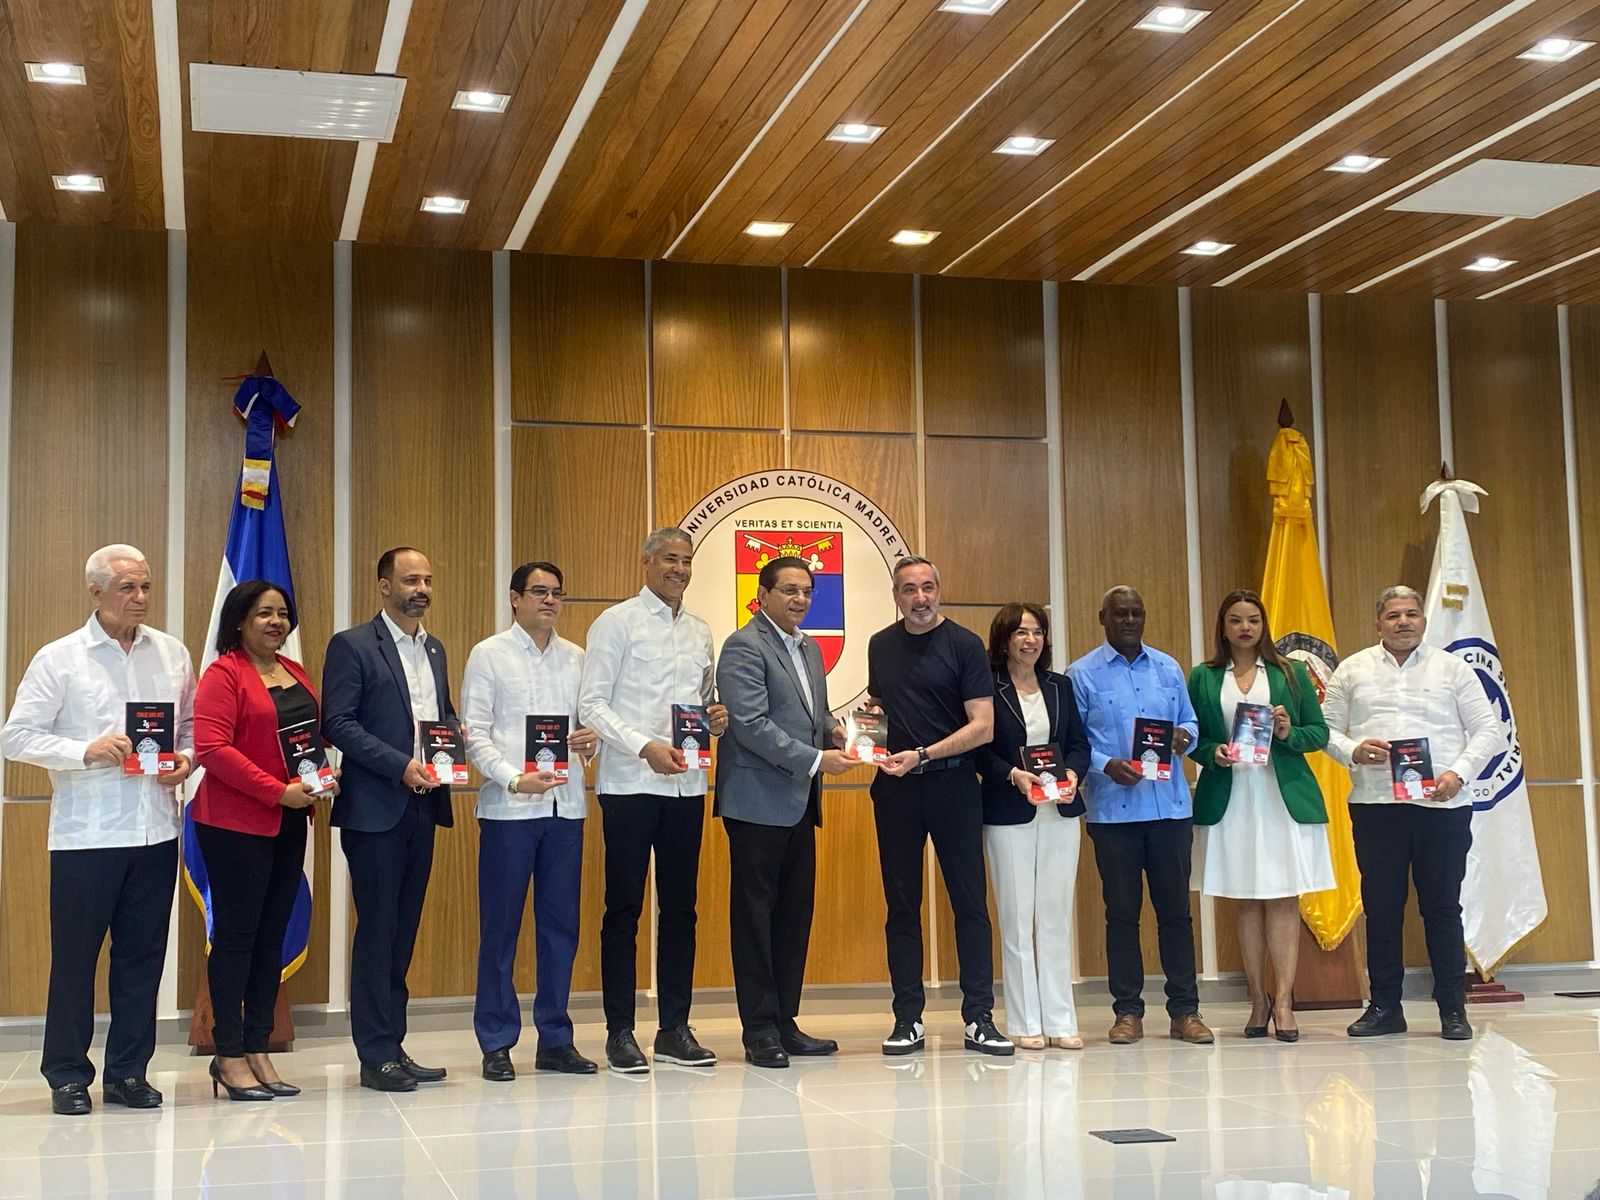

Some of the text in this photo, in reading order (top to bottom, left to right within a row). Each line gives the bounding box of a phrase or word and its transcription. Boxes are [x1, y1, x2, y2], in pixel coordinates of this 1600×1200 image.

[686, 475, 905, 558] NIVERSIDAD CATÓLICA MADRE Y
[735, 519, 843, 530] VERITAS ET SCIENTIA
[1463, 652, 1493, 671] CINA
